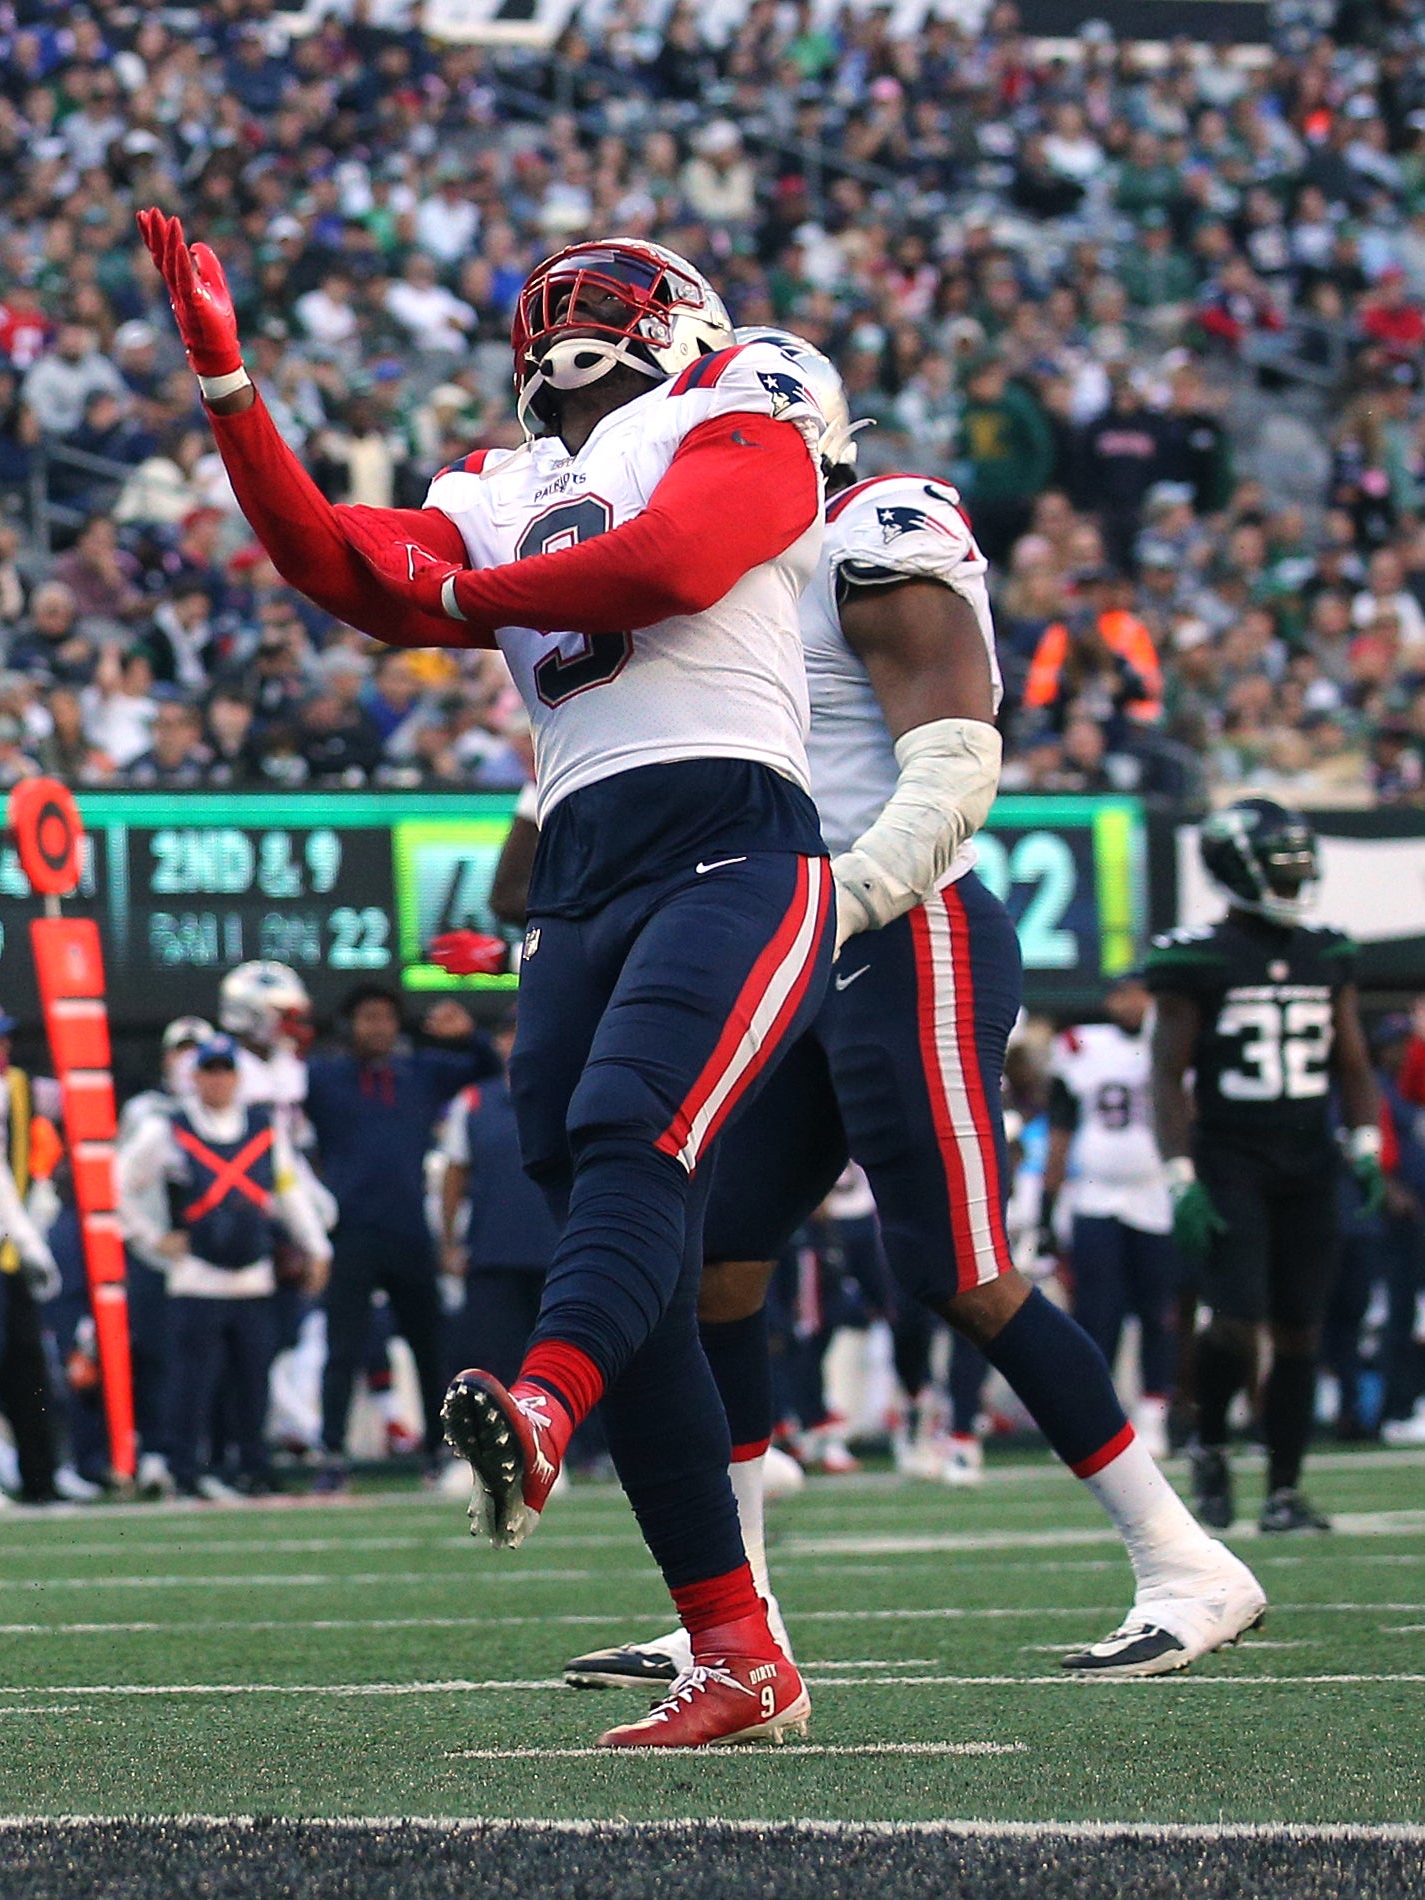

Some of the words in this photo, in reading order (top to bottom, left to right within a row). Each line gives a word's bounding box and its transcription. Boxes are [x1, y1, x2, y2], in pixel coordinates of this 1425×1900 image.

[533, 472, 587, 503] PATRIOTS
[149, 829, 255, 895] 2ND
[306, 828, 342, 895] 9
[327, 905, 393, 970] 22
[1215, 1001, 1336, 1101] 32
[750, 1664, 777, 1685] DIRTY
[761, 1686, 775, 1718] 9
